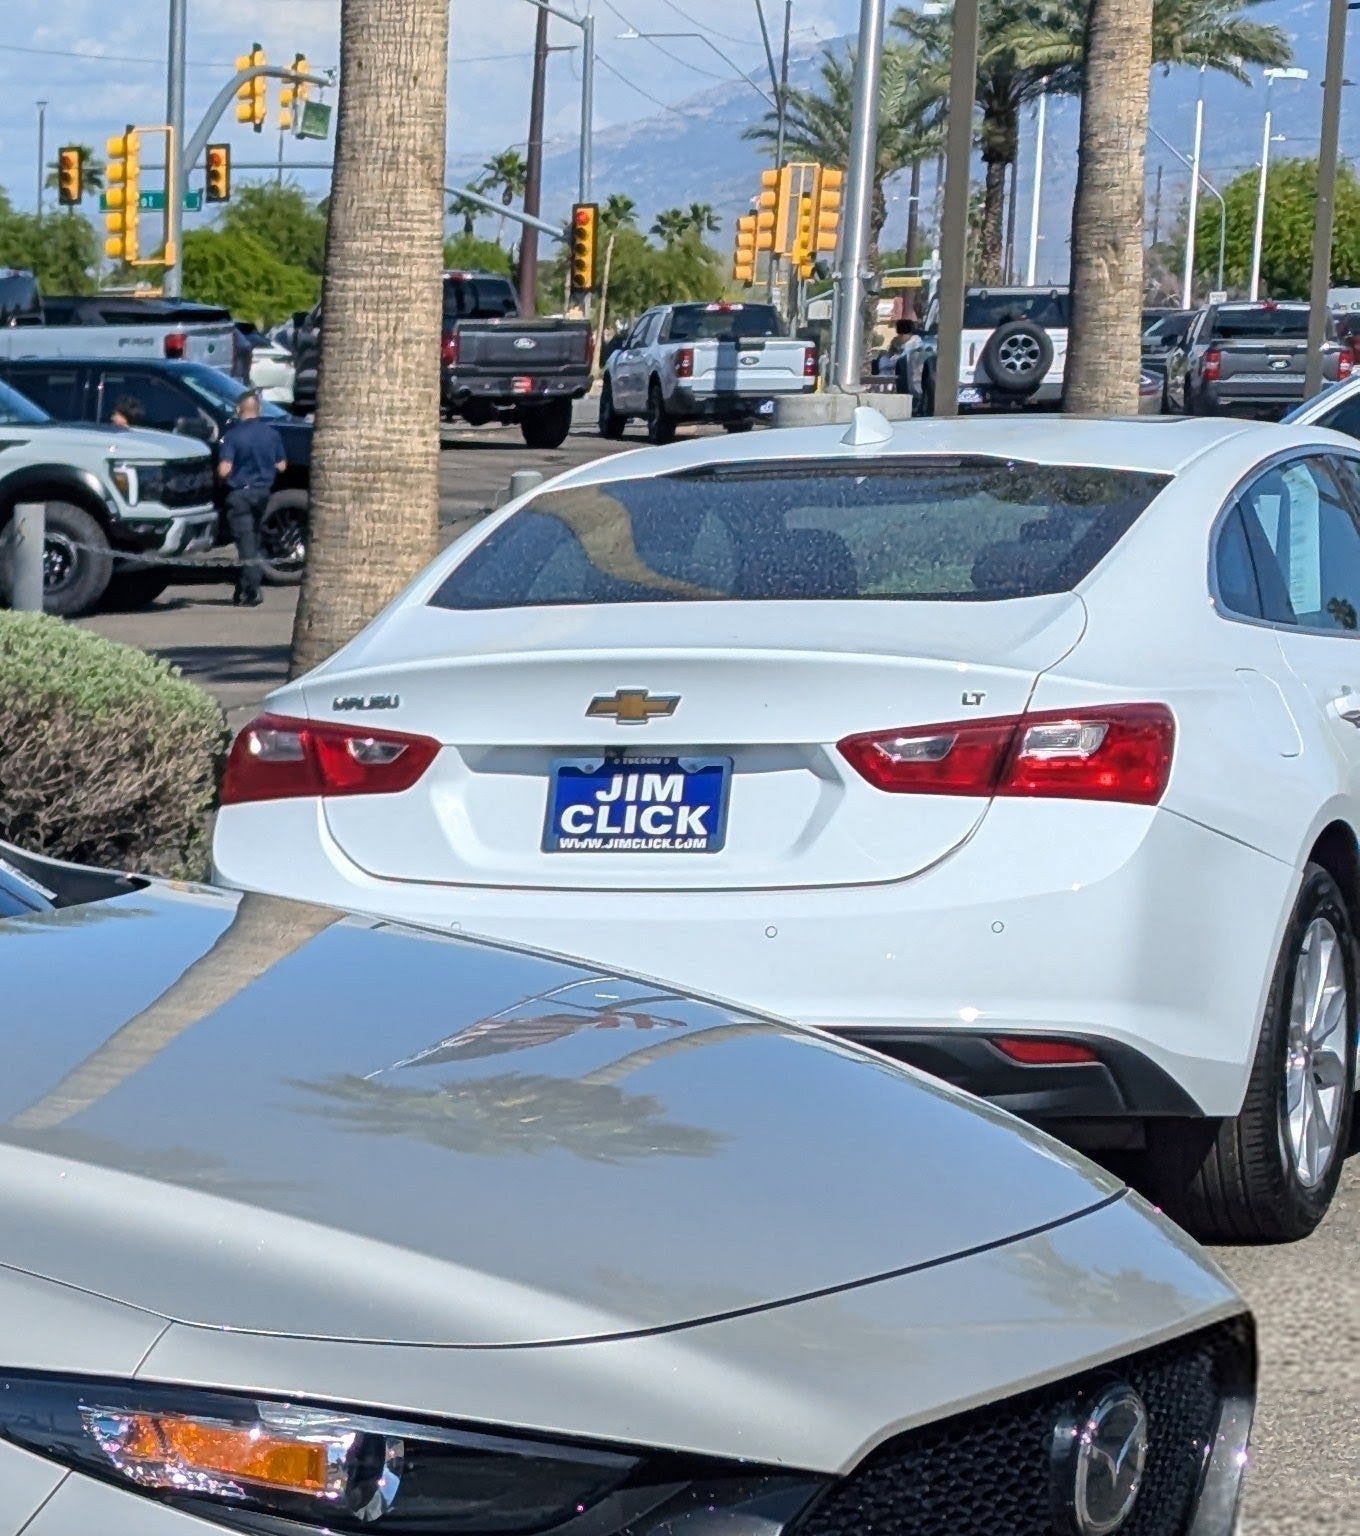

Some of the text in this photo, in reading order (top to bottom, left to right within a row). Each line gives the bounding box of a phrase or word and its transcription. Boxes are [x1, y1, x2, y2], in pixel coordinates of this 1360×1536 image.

[332, 694, 400, 711] MALIBU
[961, 692, 986, 706] LT
[595, 773, 685, 803] JIM
[560, 804, 711, 835] CLICK
[559, 837, 707, 849] WWW.JIMCLICK.COM
